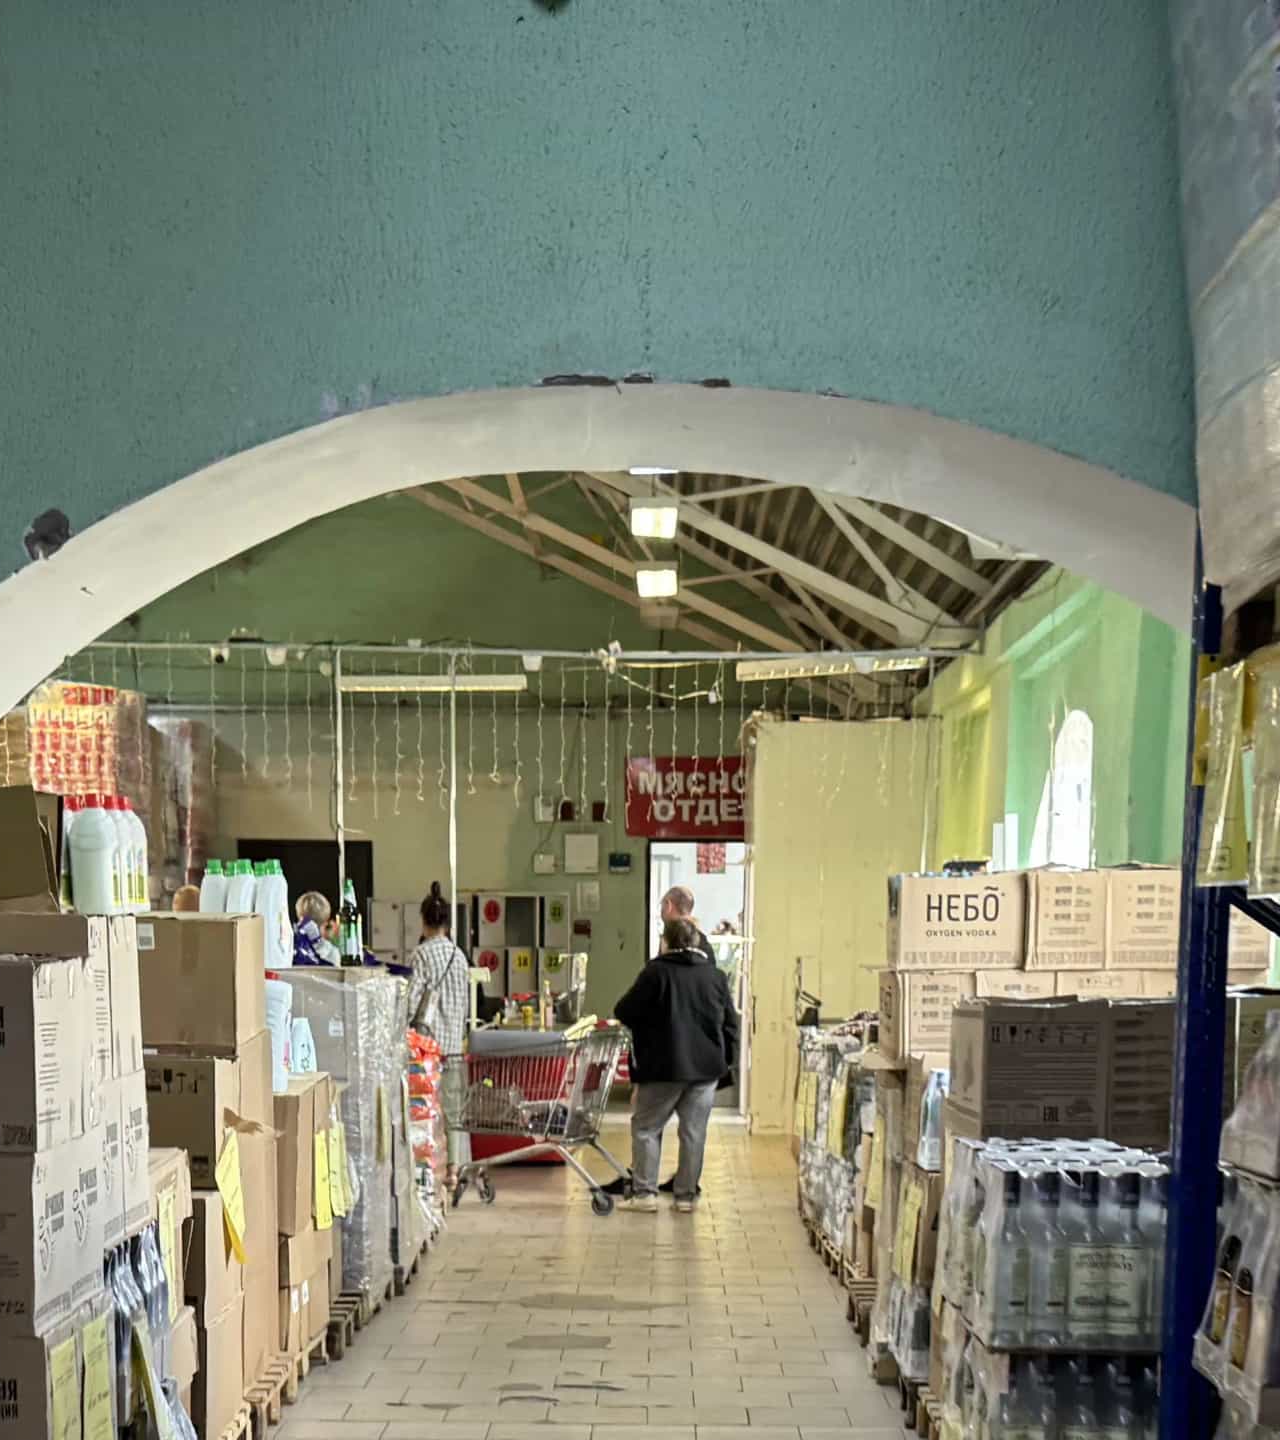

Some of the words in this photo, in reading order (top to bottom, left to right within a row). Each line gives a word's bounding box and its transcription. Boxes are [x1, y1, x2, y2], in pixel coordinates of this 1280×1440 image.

[638, 770, 745, 797] МЯСНО
[653, 798, 745, 827] ОТДЕ
[925, 928, 963, 937] OXYGEN
[965, 928, 998, 937] VODKA
